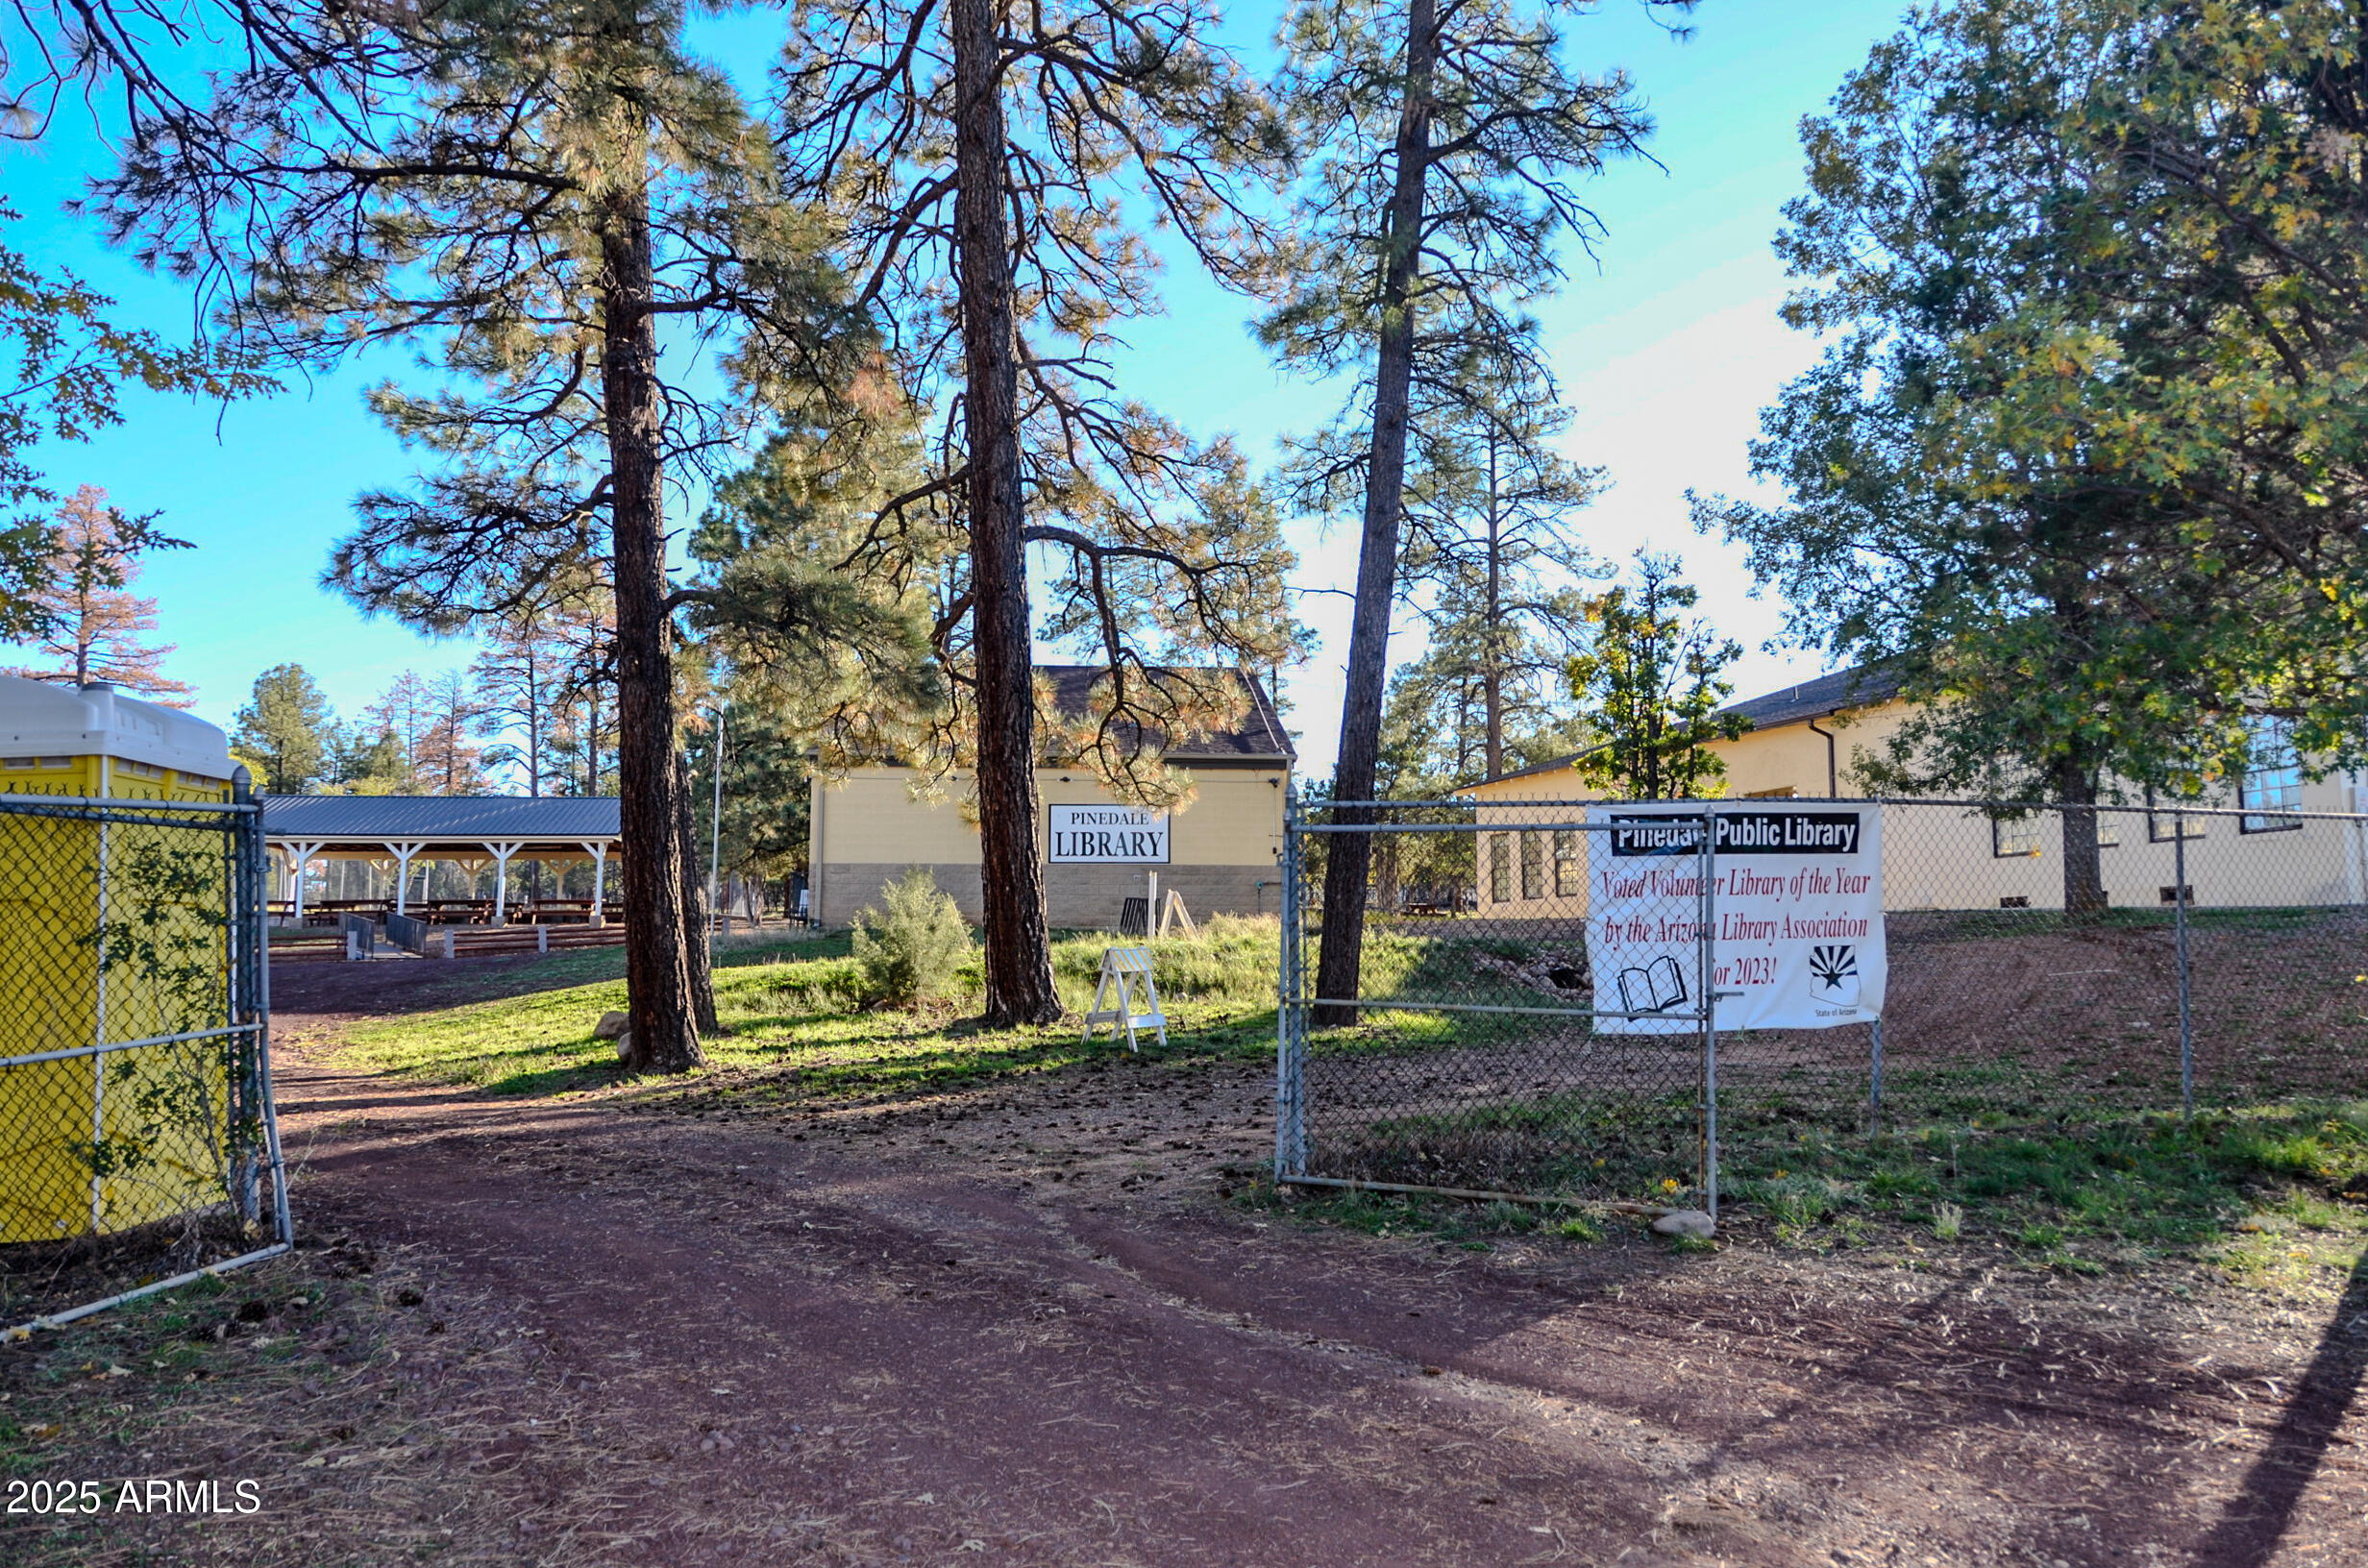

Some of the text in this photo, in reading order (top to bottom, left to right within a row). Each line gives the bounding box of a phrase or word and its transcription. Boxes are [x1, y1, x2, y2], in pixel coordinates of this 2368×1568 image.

[1072, 812, 1148, 825] PINEDALE
[1055, 831, 1164, 857] LIBRARY
[1716, 818, 1781, 845] Public
[1785, 818, 1856, 852] Library
[1603, 871, 1646, 899] Voted
[1729, 869, 1786, 902] Library
[1789, 867, 1808, 902] of
[1808, 867, 1832, 894] the
[1836, 867, 1871, 894] Year
[1604, 916, 1622, 951] by
[1627, 915, 1652, 943] the
[1722, 913, 1778, 946] Library
[1781, 911, 1868, 940] Association
[1734, 957, 1777, 986] 2023!
